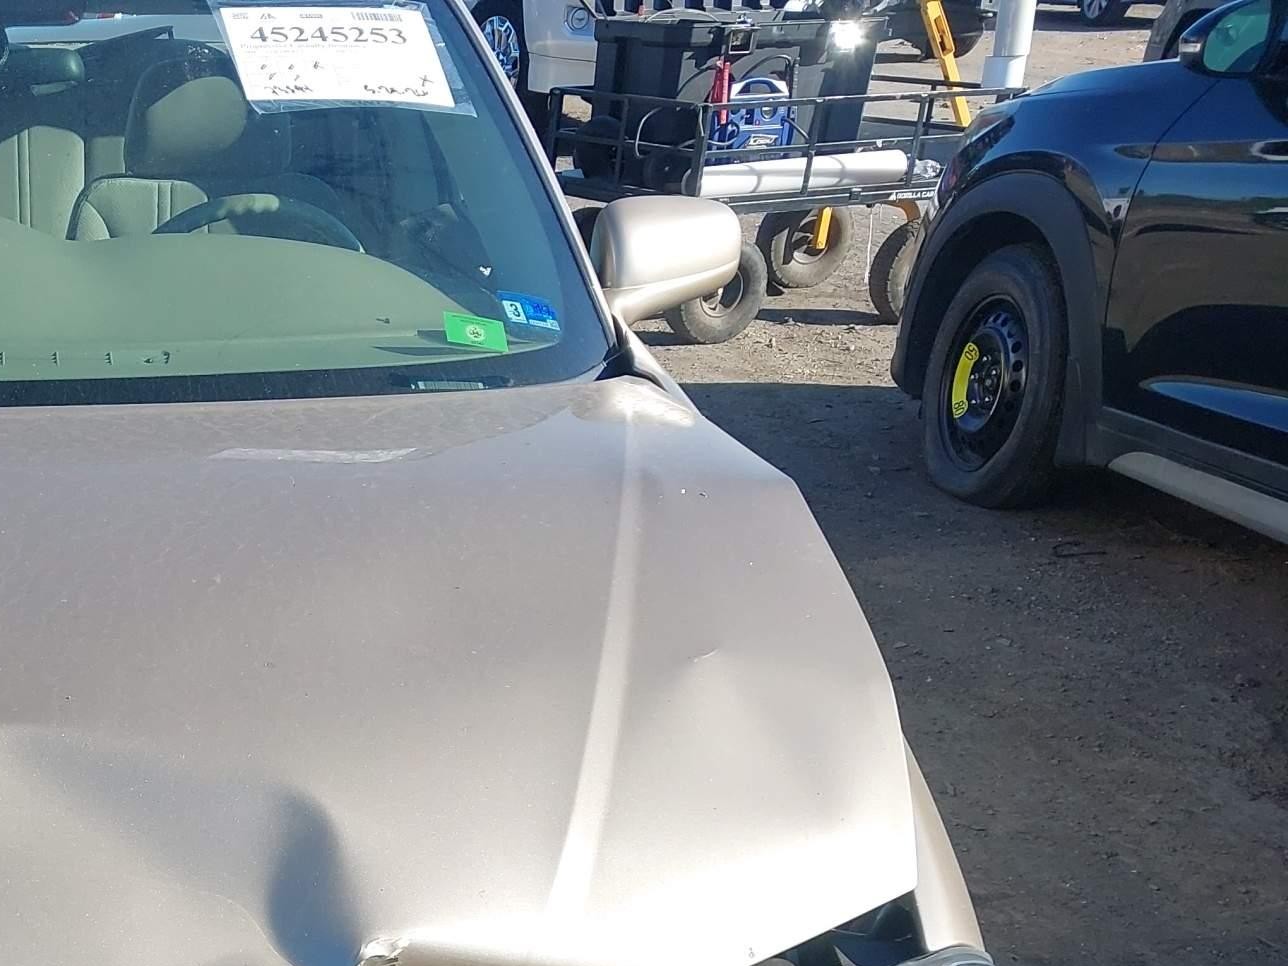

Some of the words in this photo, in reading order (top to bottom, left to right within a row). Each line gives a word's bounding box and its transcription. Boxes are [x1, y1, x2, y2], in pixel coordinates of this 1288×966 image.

[250, 26, 408, 45] 45245253
[509, 303, 521, 318] 3
[964, 345, 978, 361] 50
[953, 400, 966, 416] 80
